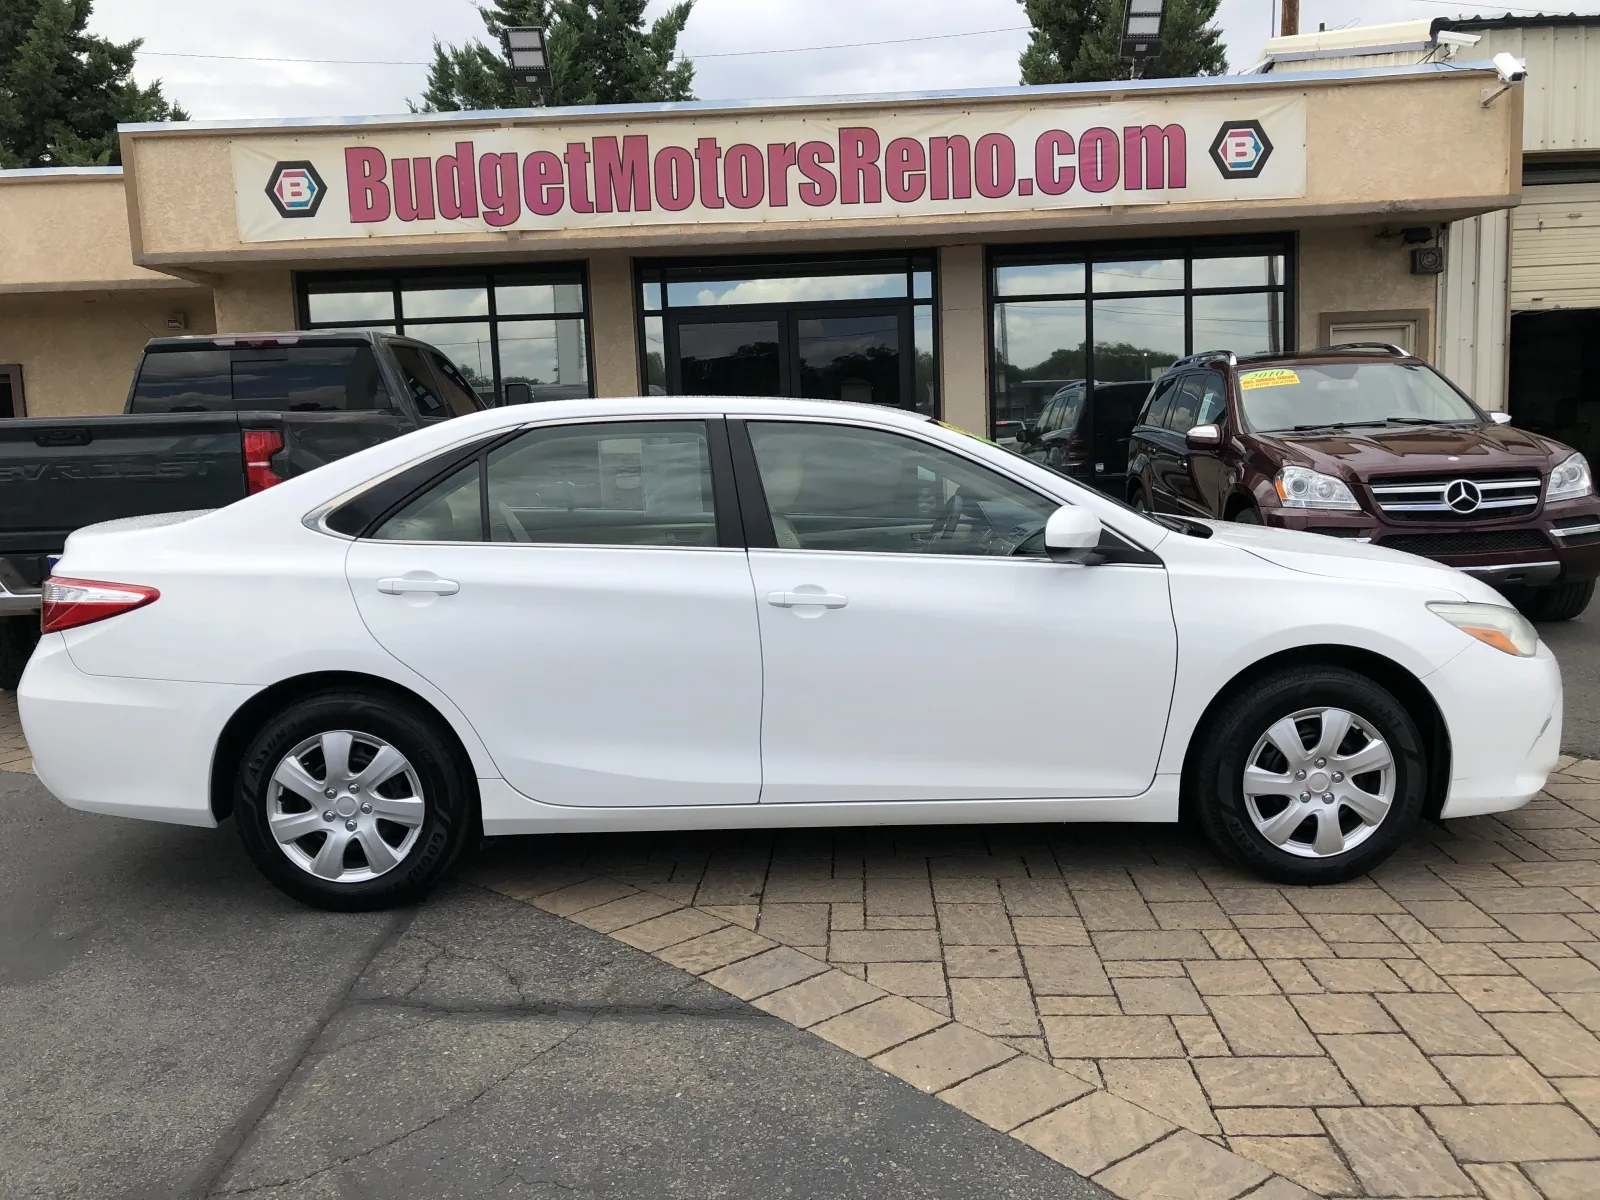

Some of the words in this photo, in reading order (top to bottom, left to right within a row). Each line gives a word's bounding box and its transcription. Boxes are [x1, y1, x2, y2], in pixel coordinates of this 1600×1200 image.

[1226, 136, 1257, 163] B
[344, 123, 1187, 227] BudgetMotorsReno.com
[281, 176, 311, 203] B
[1250, 370, 1285, 380] 2010
